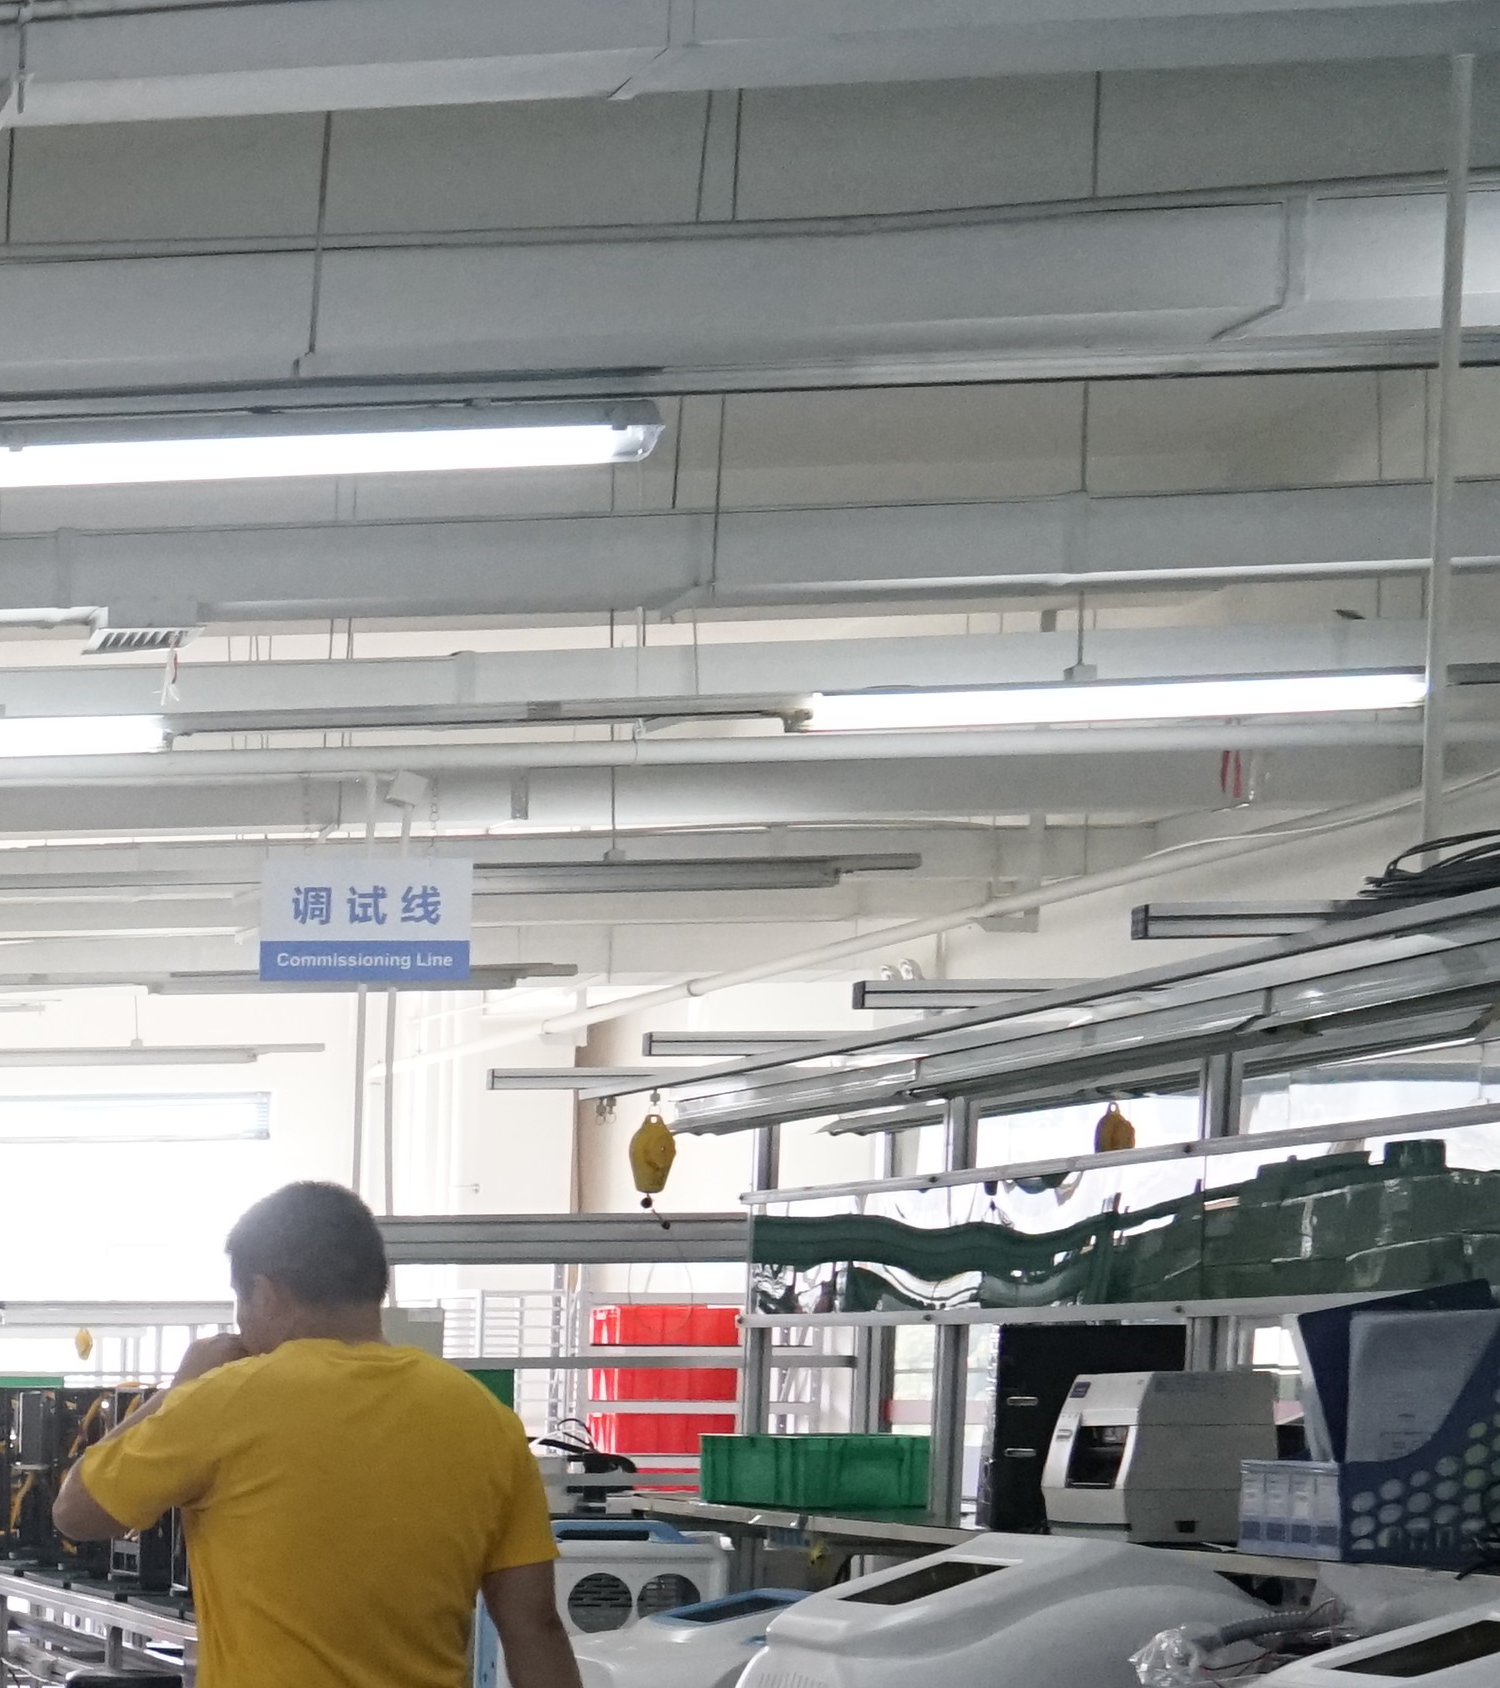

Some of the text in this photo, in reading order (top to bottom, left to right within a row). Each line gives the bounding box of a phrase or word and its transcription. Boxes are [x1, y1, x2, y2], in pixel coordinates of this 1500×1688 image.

[292, 885, 442, 925] 调试线
[277, 952, 453, 970] Commissioning Line
